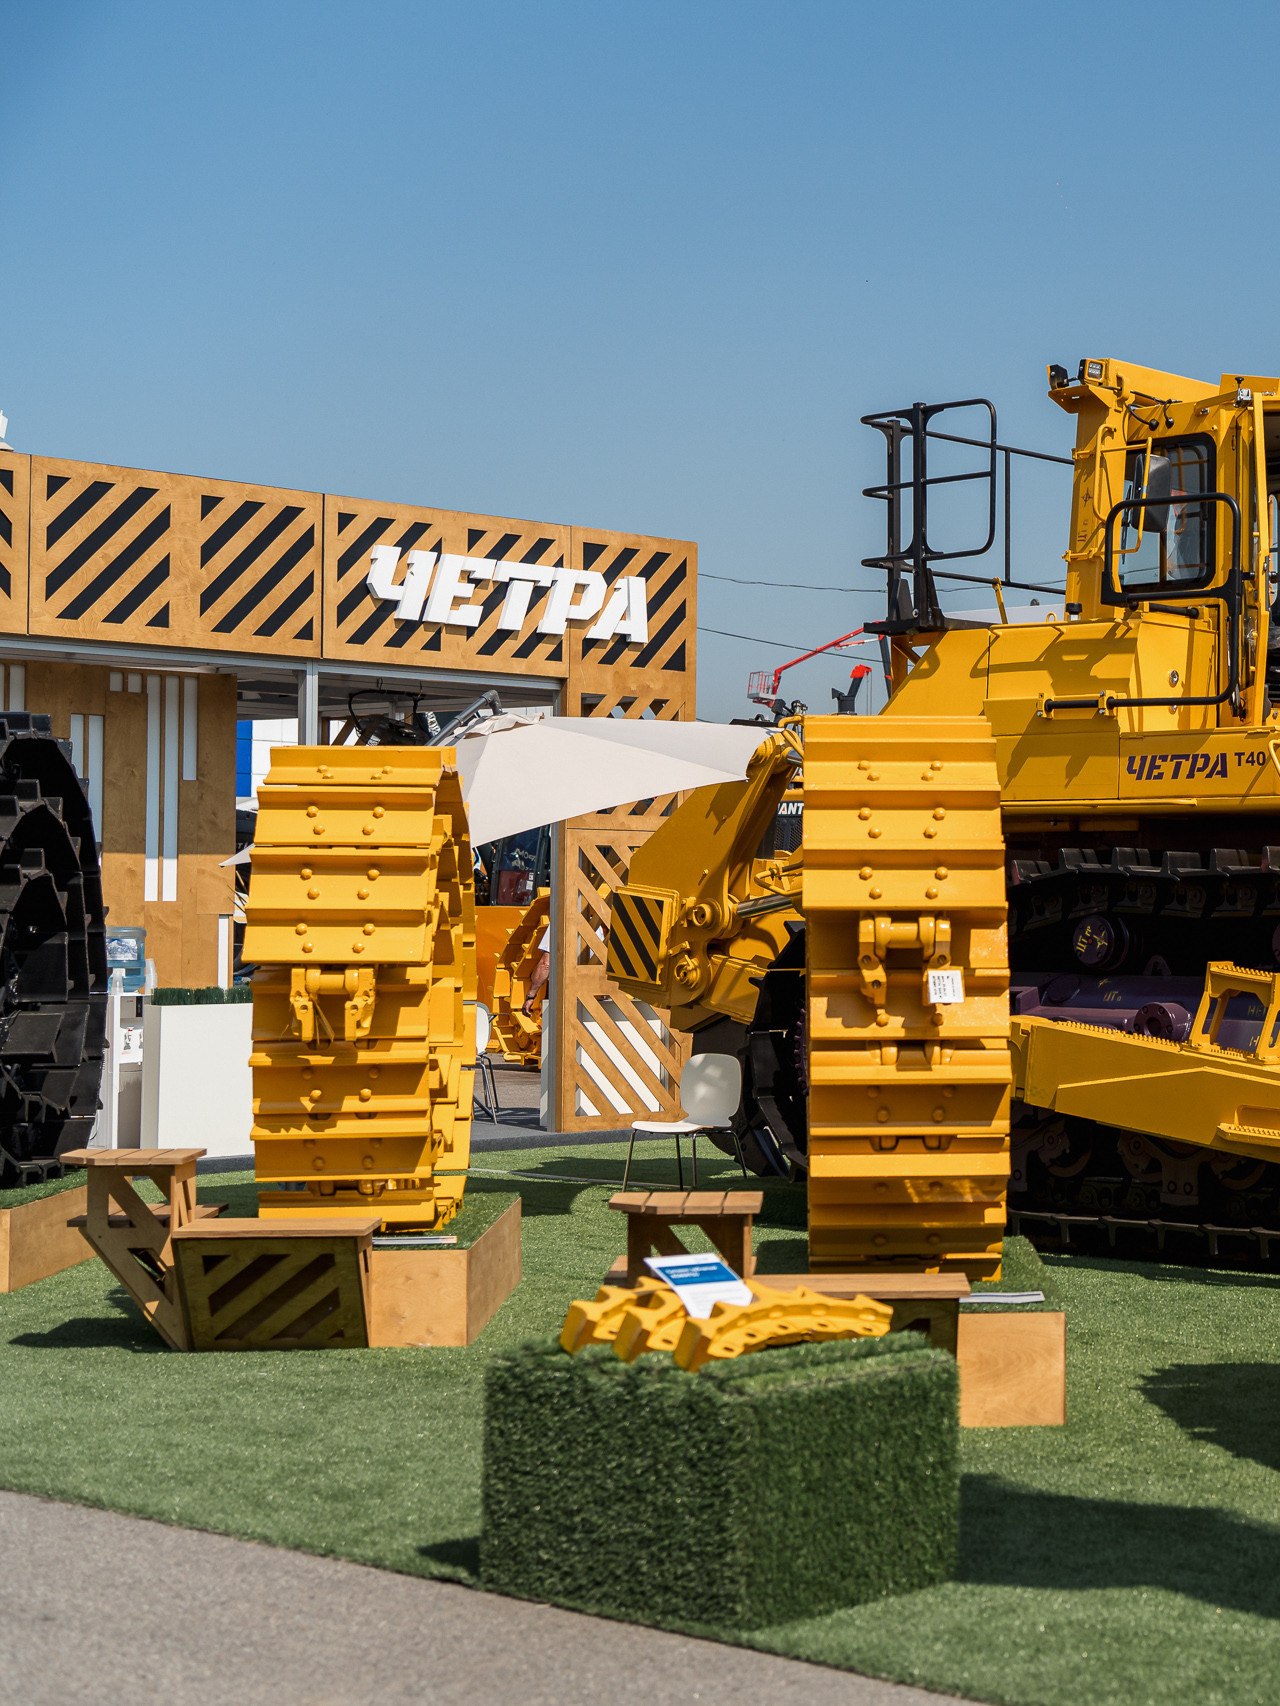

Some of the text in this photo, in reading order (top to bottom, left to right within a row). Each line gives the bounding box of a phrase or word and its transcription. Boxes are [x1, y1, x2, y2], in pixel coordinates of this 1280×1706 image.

[366, 545, 649, 643] ЧЕТРА
[1126, 753, 1228, 781] ЧЕТРА
[777, 802, 805, 815] ANT
